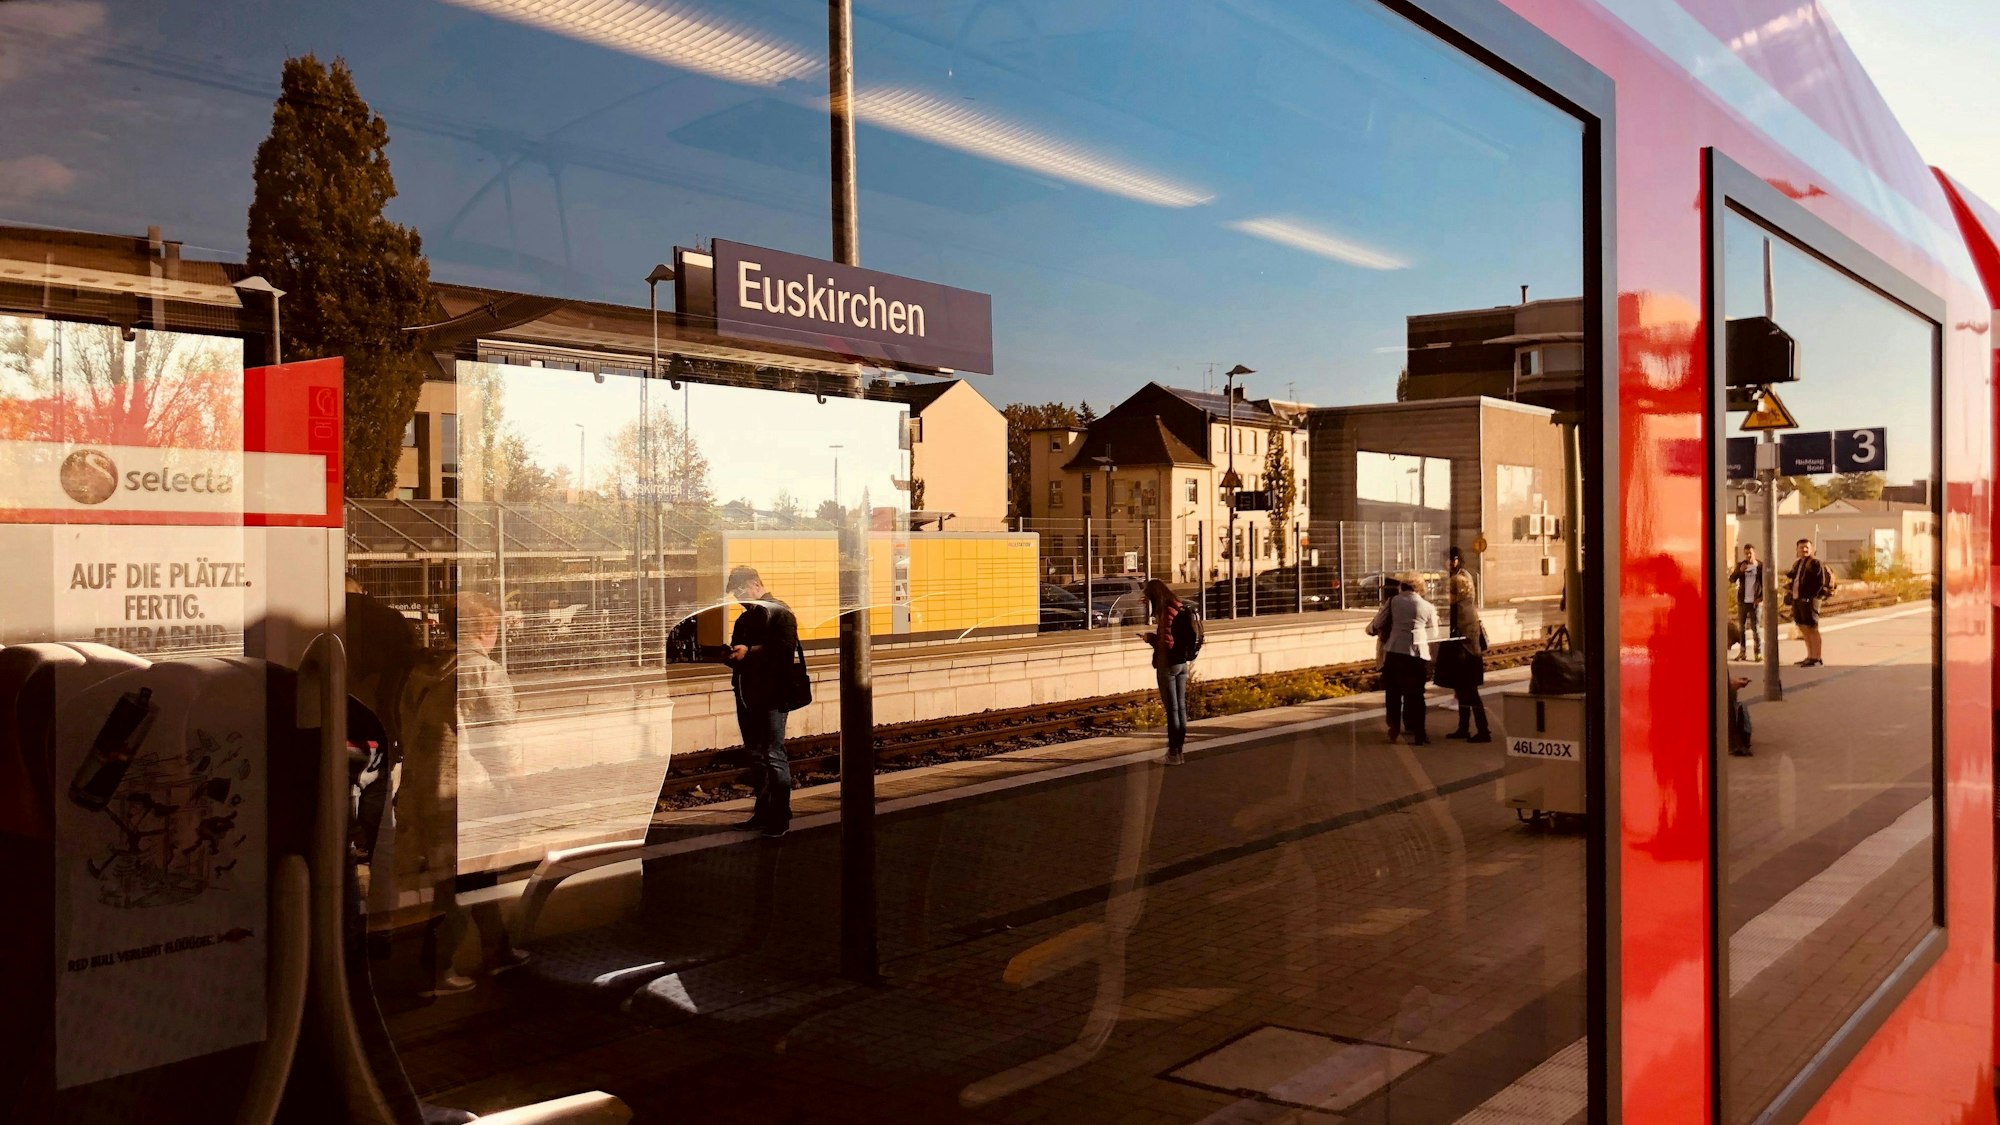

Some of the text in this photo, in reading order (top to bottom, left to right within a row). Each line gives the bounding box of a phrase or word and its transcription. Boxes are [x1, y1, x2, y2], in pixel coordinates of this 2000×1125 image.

[738, 261, 925, 337] Euskirchen
[1851, 429, 1876, 463] 3
[124, 466, 234, 494] selecta
[70, 556, 252, 590] AUF DIE PLÄTZE.
[125, 594, 205, 621] FERTIG.
[1513, 740, 1572, 758] 46L203X
[67, 958, 89, 972] RED
[91, 955, 115, 969] BULL
